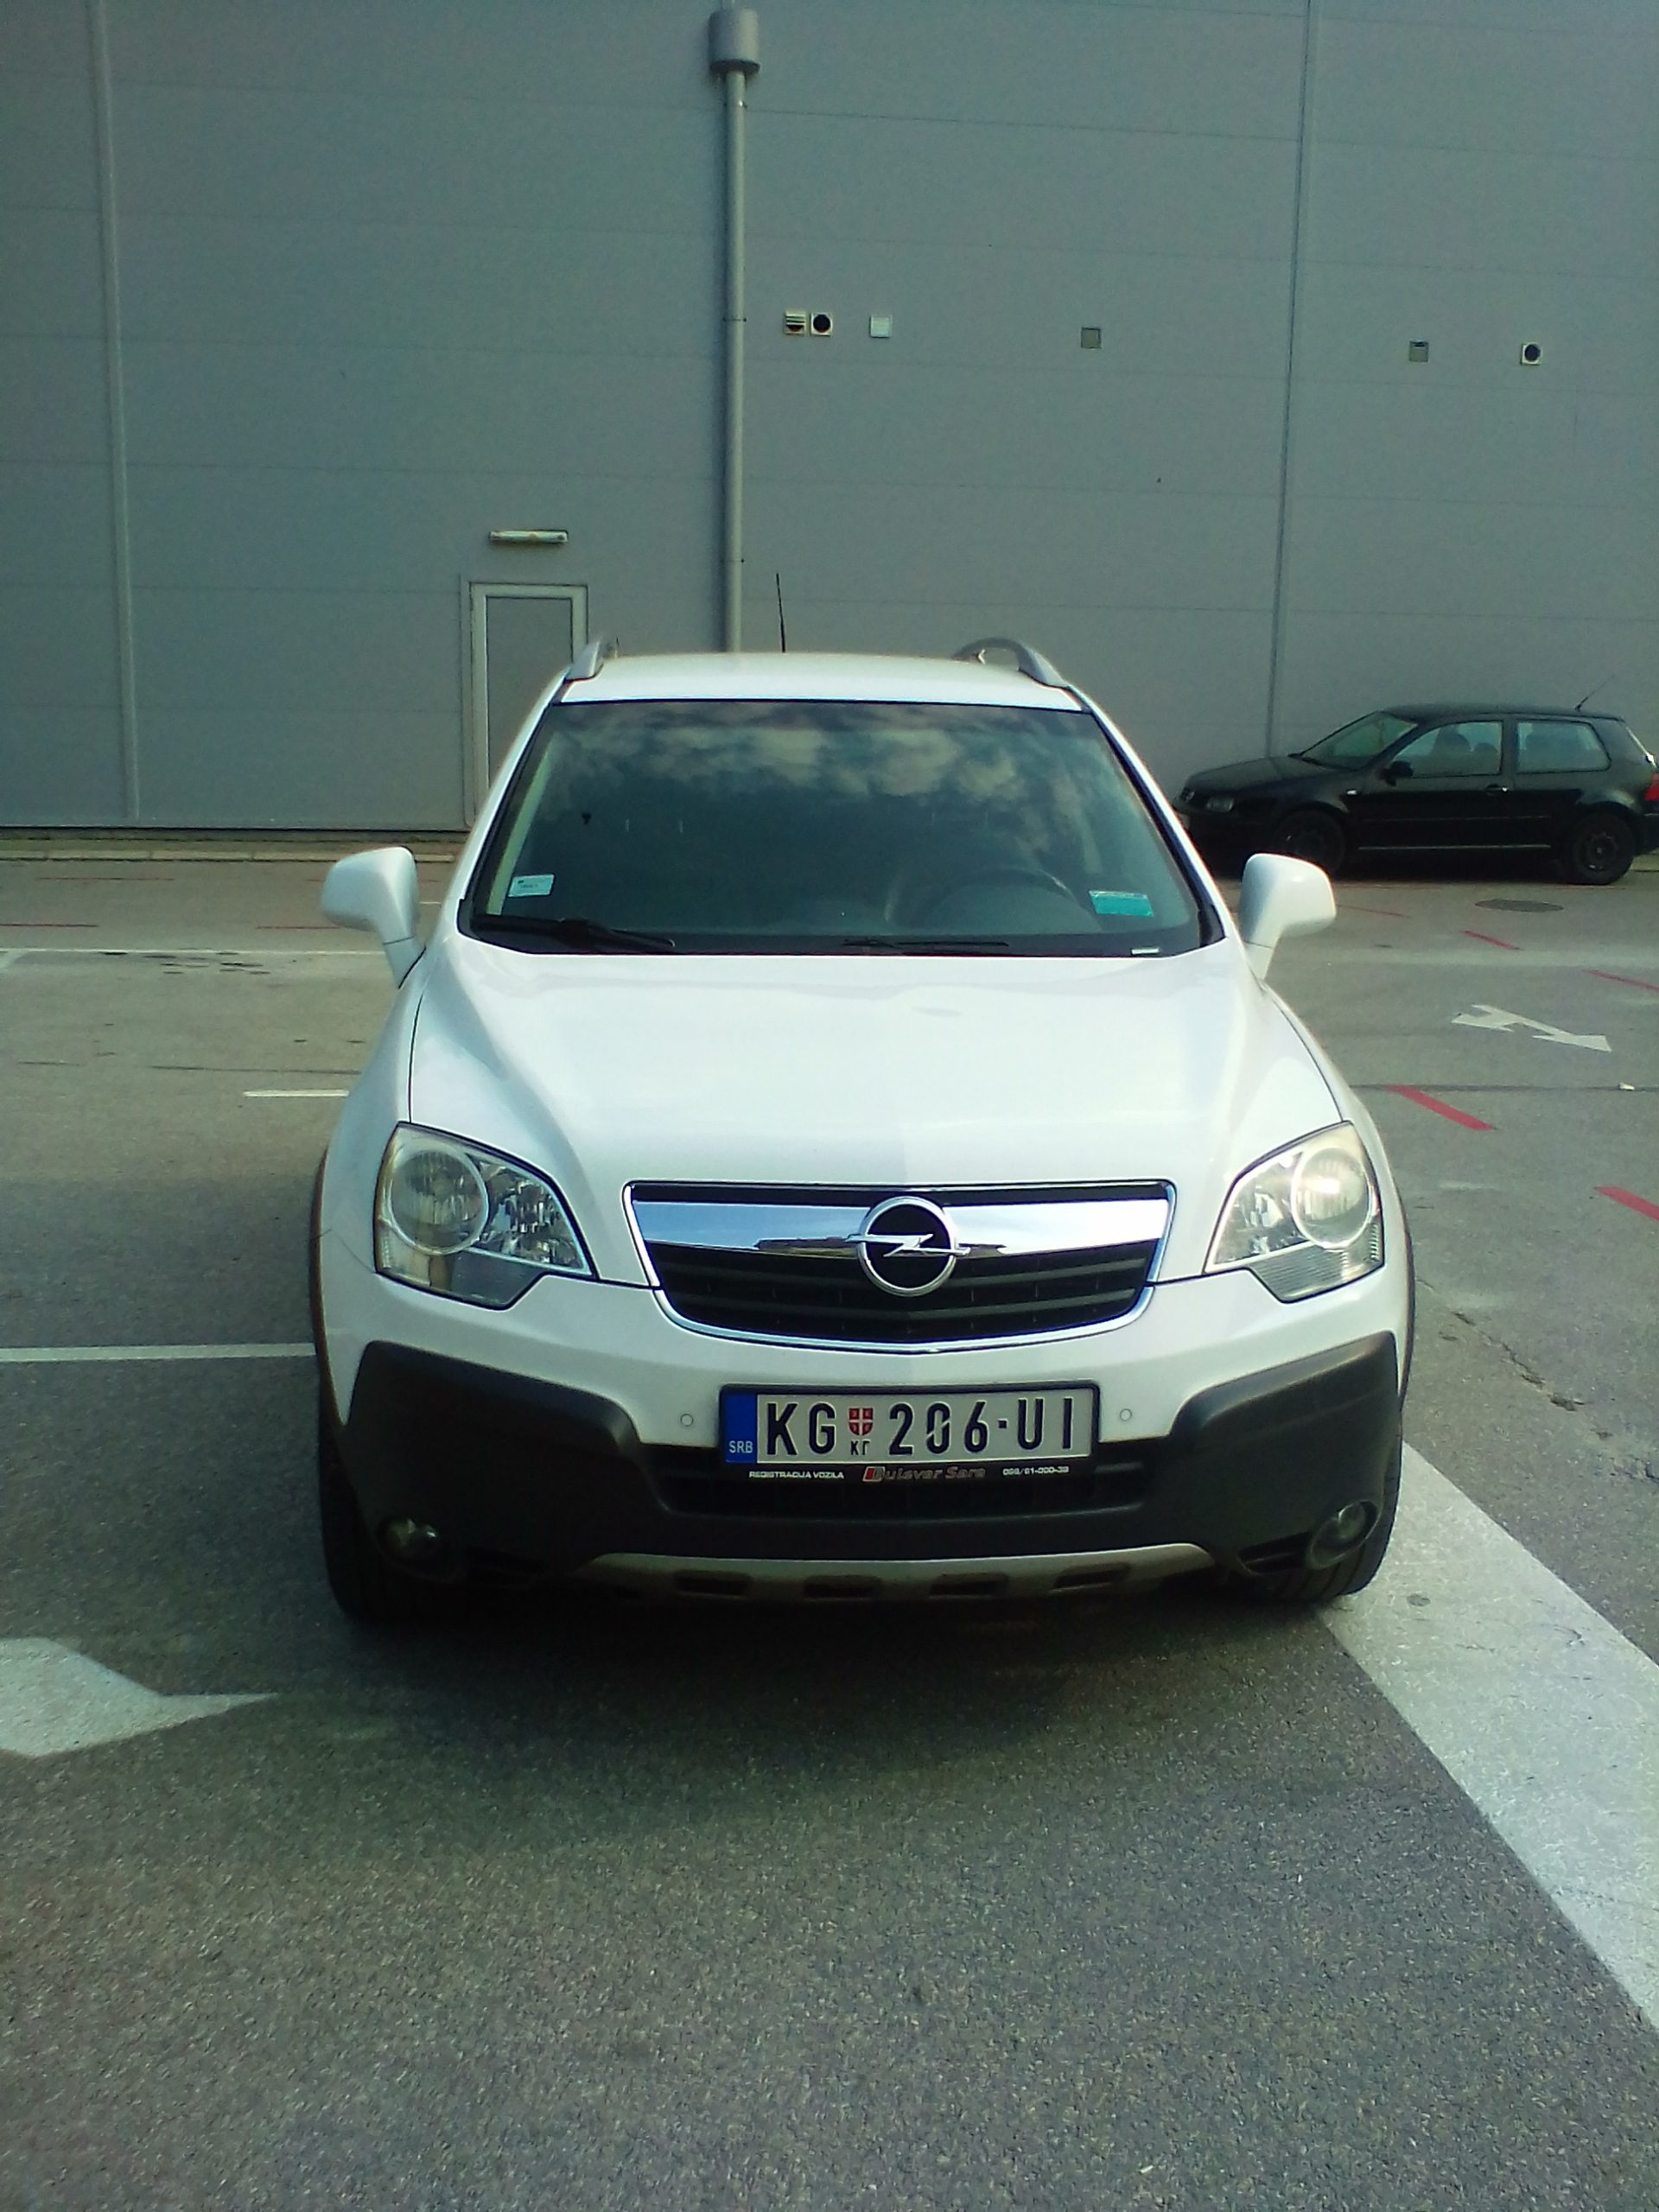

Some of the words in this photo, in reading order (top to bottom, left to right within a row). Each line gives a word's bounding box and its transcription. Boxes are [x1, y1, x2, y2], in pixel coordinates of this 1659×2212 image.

[766, 1401, 836, 1457] KG
[728, 1440, 753, 1454] SRB
[748, 1471, 812, 1479] REGISTRACIJA
[813, 1471, 845, 1479] VOZILA
